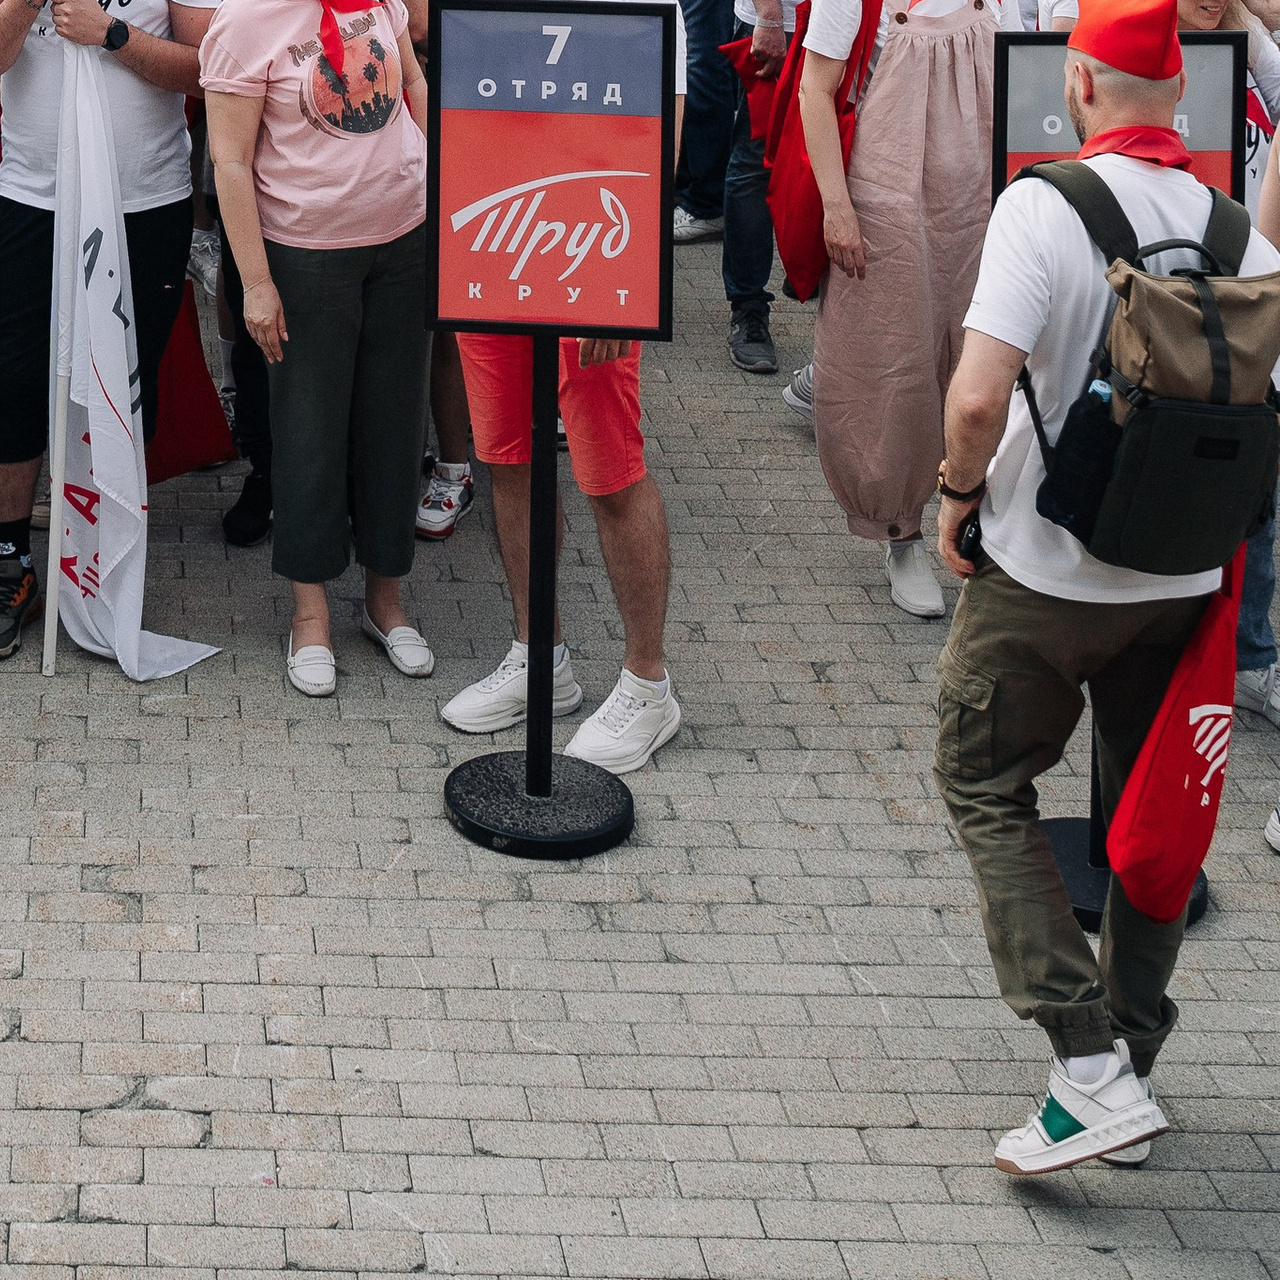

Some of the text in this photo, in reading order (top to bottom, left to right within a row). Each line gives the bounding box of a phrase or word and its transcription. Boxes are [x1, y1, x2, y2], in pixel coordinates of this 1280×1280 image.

[287, 39, 323, 68] THE
[541, 24, 572, 65] 7
[477, 77, 623, 106] ОТРЯД
[449, 169, 651, 282] Труд
[468, 282, 629, 305] КРУТ
